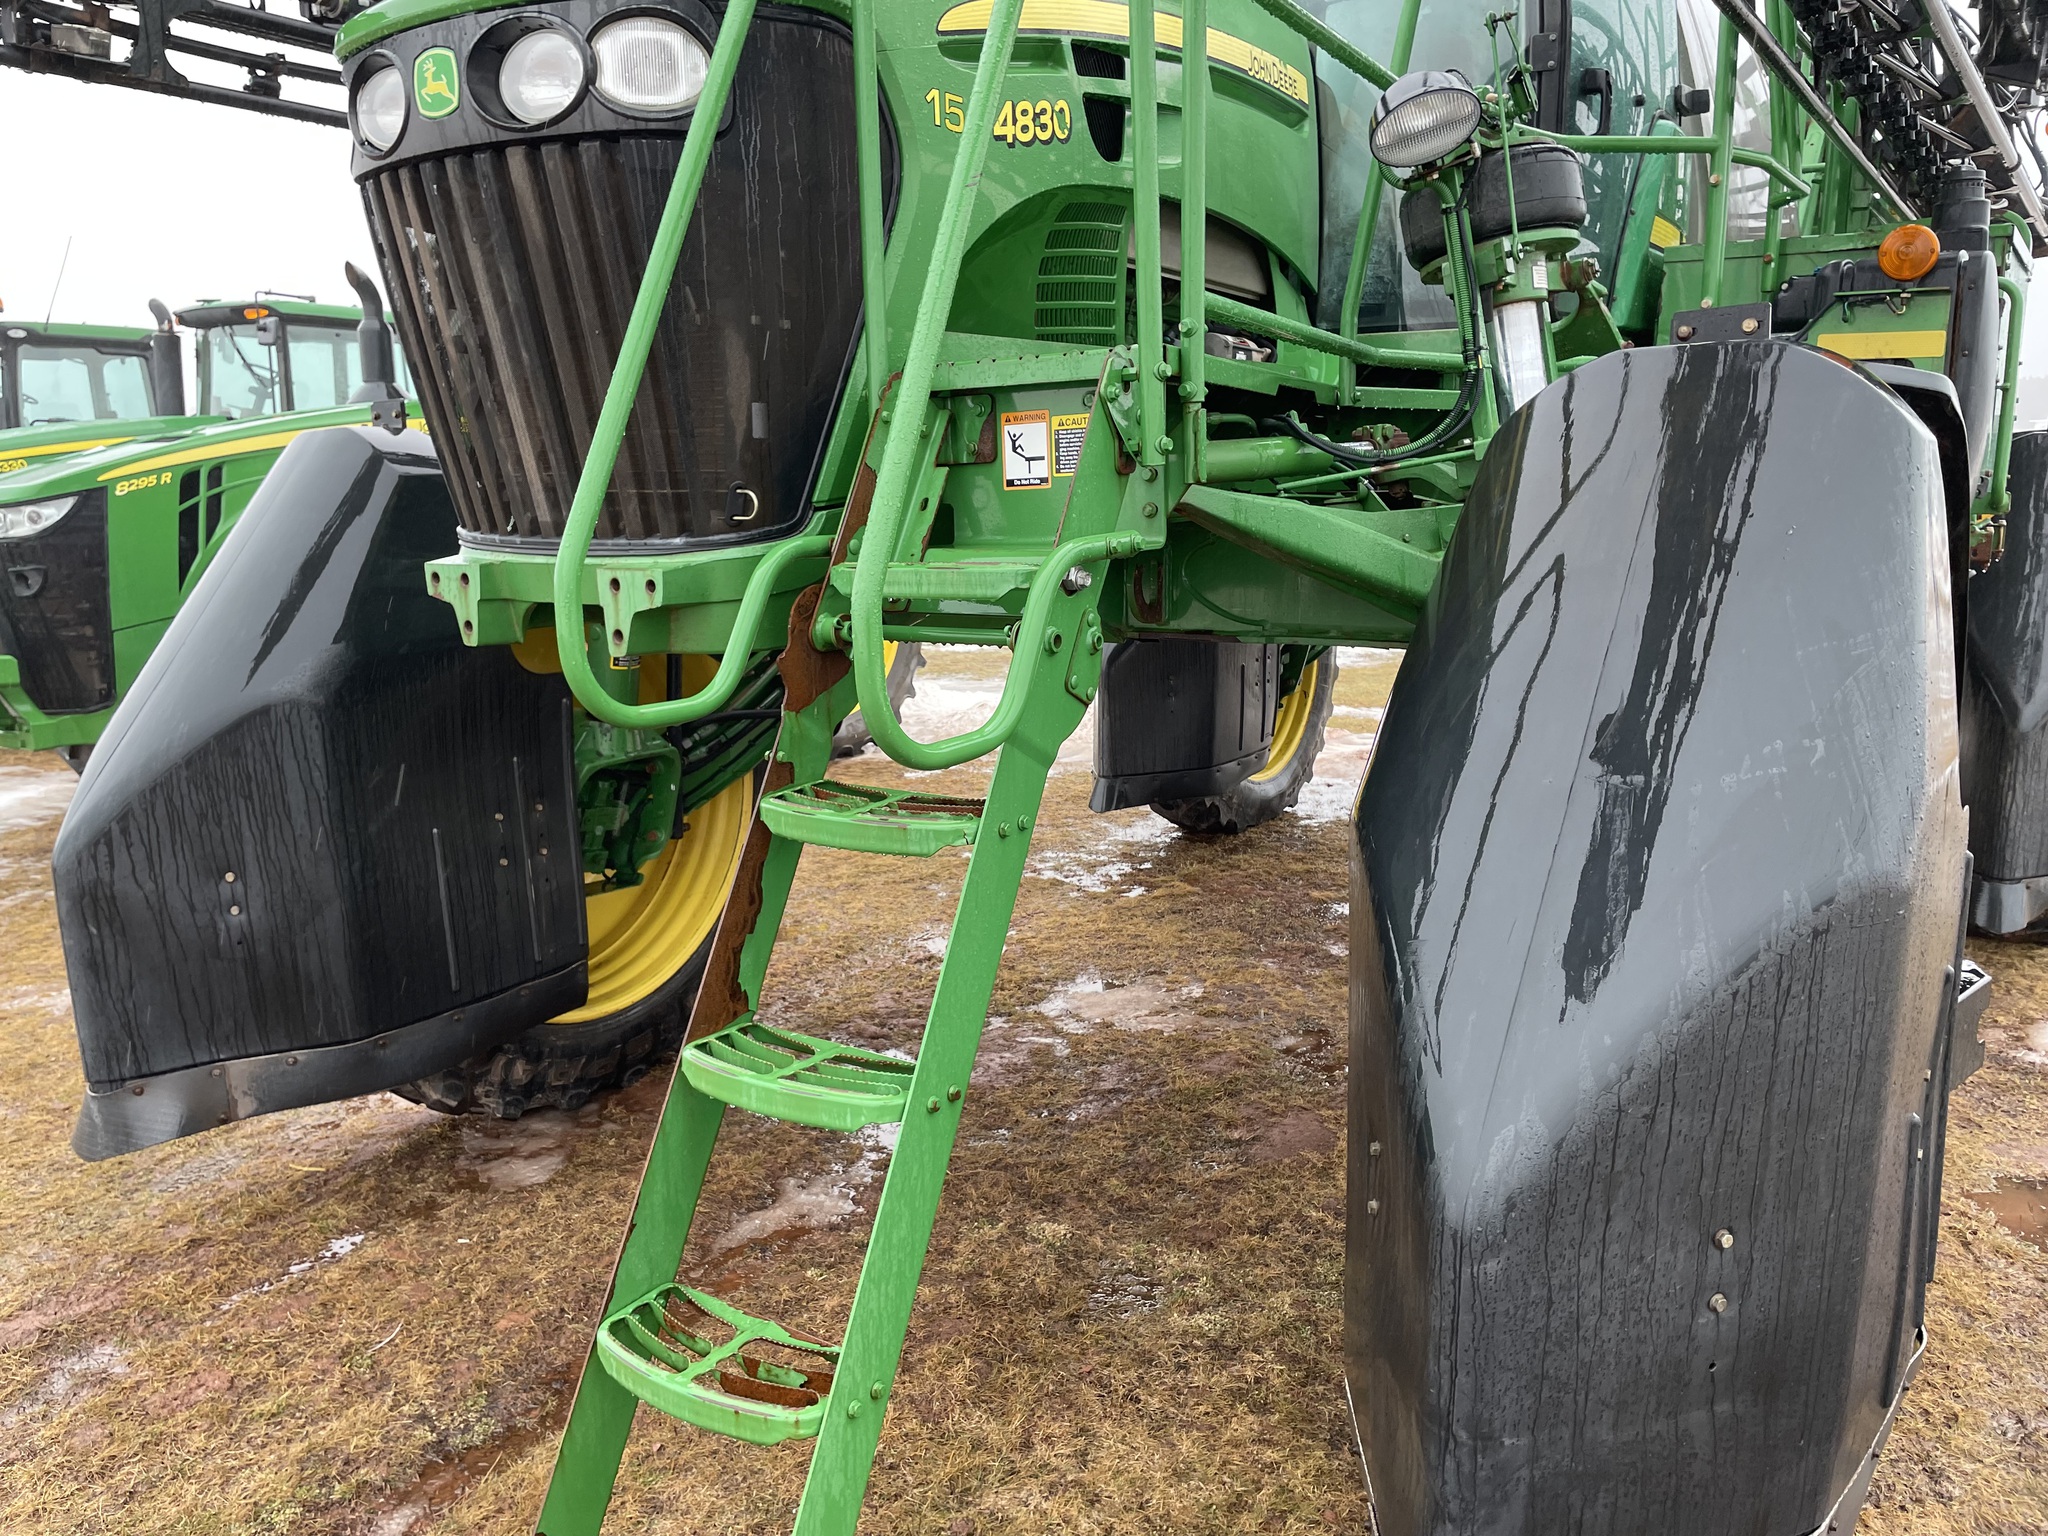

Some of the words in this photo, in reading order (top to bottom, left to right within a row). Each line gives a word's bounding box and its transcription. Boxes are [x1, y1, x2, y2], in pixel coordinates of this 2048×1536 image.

[1247, 49, 1272, 84] JOHN
[1272, 61, 1299, 98] DEERE
[992, 98, 1073, 149] 4830
[1013, 413, 1046, 422] WARNING
[1065, 417, 1087, 426] CAUT
[115, 475, 157, 496] 8295
[161, 472, 172, 486] R
